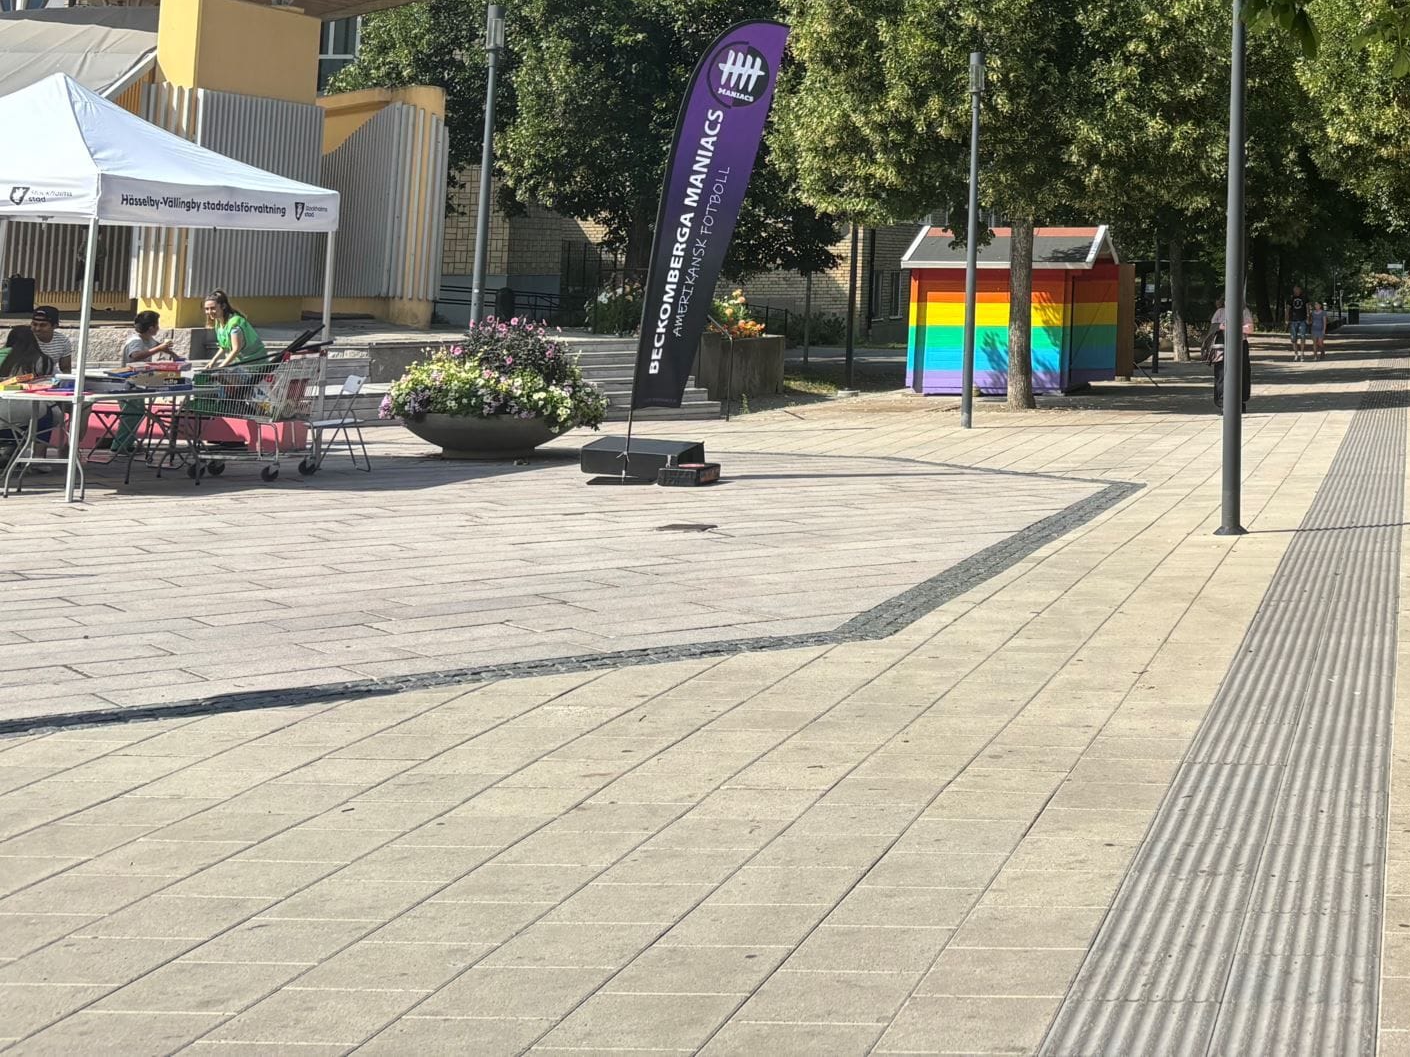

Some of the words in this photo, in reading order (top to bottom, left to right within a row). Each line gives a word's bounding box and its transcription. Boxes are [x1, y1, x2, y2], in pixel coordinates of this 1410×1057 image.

[718, 87, 755, 103] MANIACS
[121, 193, 202, 212] Hässelby-Vällingby
[202, 201, 287, 218] stadsdelsförvaltning
[649, 212, 695, 375] BECKOMBERGA
[684, 108, 724, 207] MANIACS
[674, 238, 708, 338] AMERIKANSK
[700, 166, 731, 235] FOTBOLL
